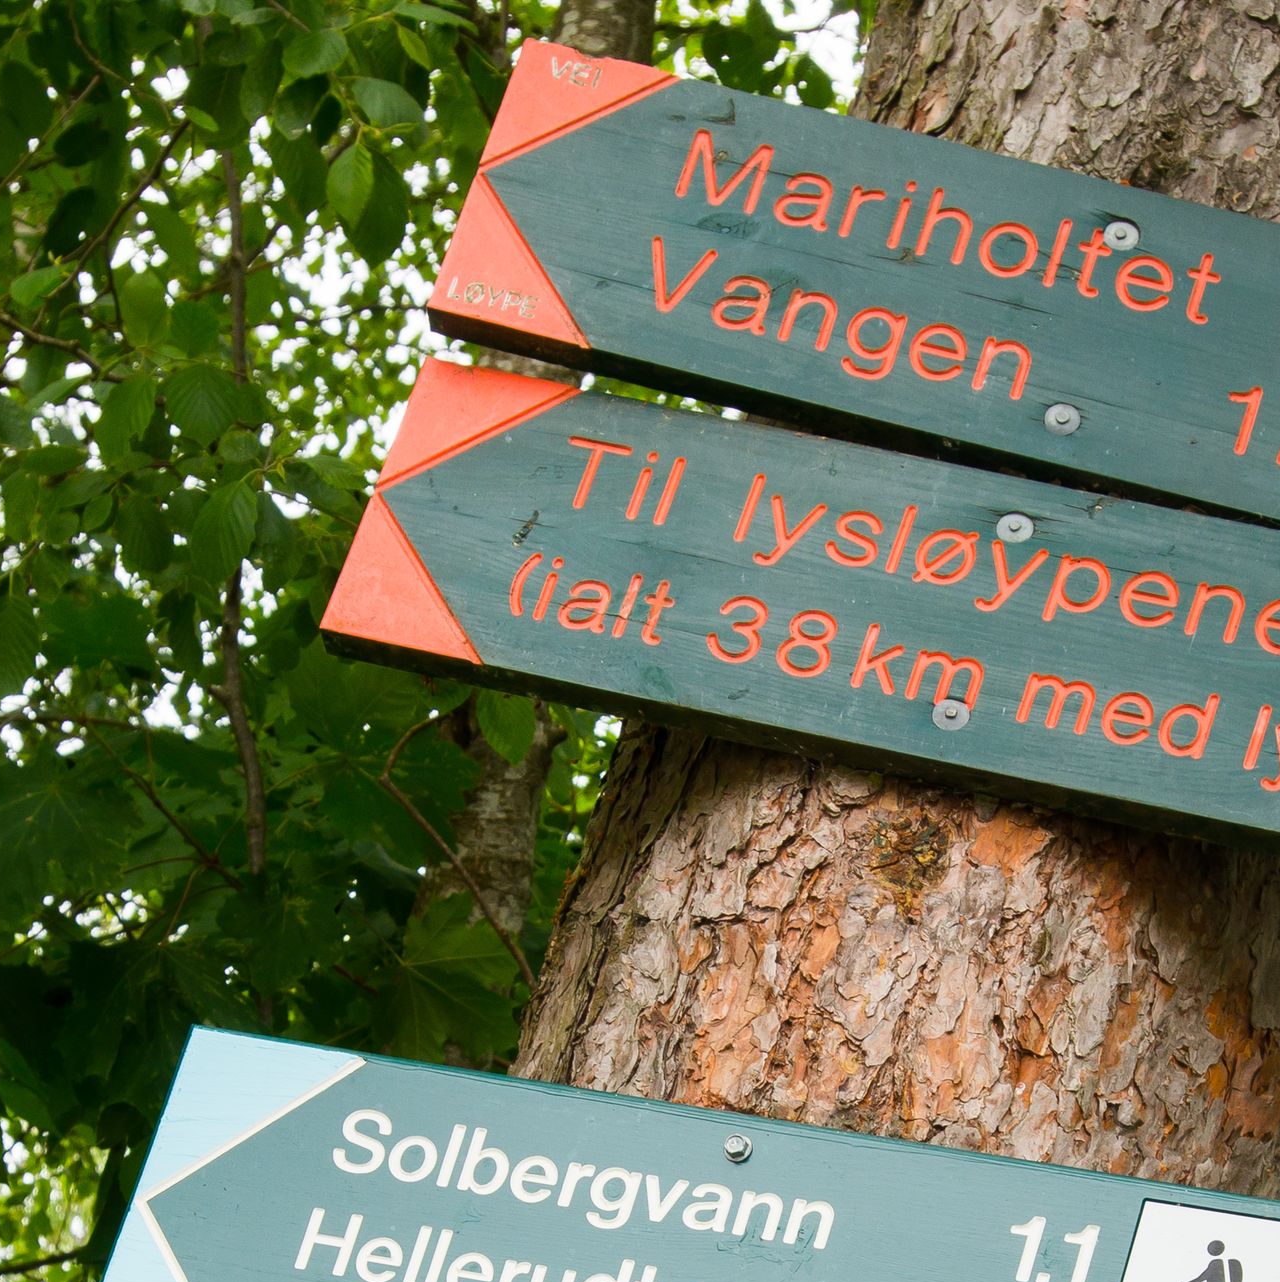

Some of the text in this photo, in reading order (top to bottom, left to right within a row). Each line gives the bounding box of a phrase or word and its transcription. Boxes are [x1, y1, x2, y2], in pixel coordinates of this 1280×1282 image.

[551, 56, 602, 88] VEI
[447, 276, 540, 318] LØYPE
[675, 129, 1221, 325] Mariholtet
[652, 236, 1032, 400] Vangen
[569, 437, 687, 525] Til
[509, 552, 674, 645] (ialt
[706, 596, 838, 677] 38
[850, 623, 985, 711] km
[1015, 672, 1220, 759] med
[332, 1109, 836, 1251] Solbergvann
